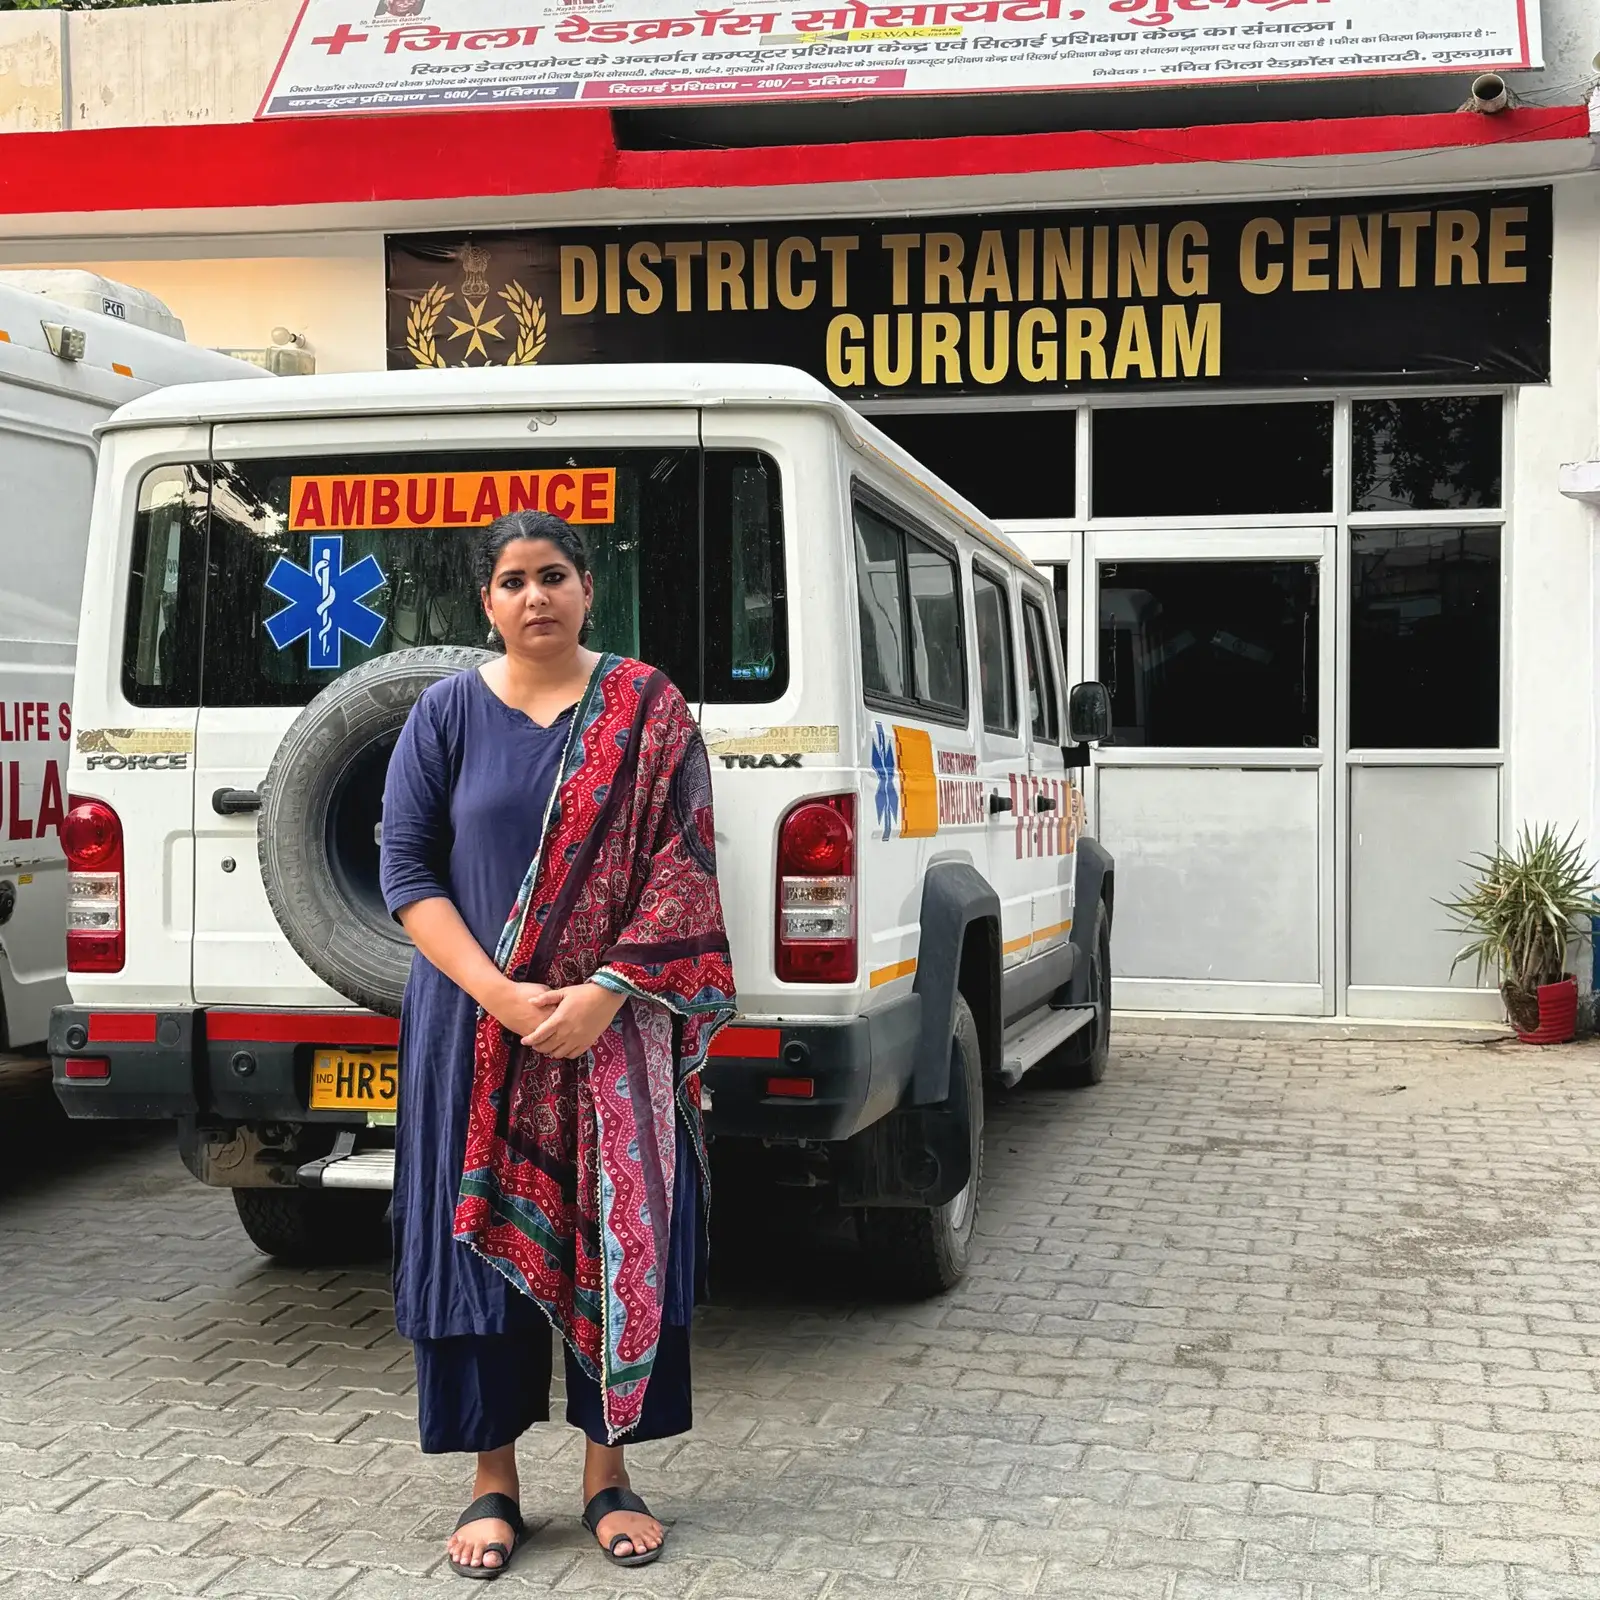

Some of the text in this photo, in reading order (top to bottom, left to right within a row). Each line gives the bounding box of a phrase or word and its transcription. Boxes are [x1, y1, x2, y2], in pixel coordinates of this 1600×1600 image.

[384, 25, 546, 54] जिला
[860, 30, 925, 39] SEWAK
[411, 62, 473, 75] स्किल
[585, 53, 609, 66] के
[612, 49, 699, 65] अन्तर्गत
[702, 48, 790, 63] कम्प्यूटर
[792, 43, 873, 59] प्रशिक्षण
[878, 40, 931, 54] केन्द्र
[935, 37, 968, 51] एवं
[973, 33, 1048, 49] सिलाई
[1051, 31, 1138, 47] प्रशिक्षण
[1143, 27, 1199, 40] केन्द्र
[1202, 25, 1237, 37] का
[1241, 21, 1336, 35] संचालन
[1026, 51, 1058, 60] सिलाई
[1124, 48, 1138, 56] का
[1253, 40, 1279, 49] किया
[1297, 40, 1316, 48] रहा
[1215, 59, 1264, 70] जिला
[608, 82, 670, 94] सिलाई
[670, 81, 738, 92] प्रशिक्षण
[808, 75, 879, 87] प्रतिमाह
[360, 93, 426, 105] प्रशिक्षण
[492, 86, 560, 98] प्रतिमाह
[559, 206, 1529, 316] DISTRICT TRAINING CENTRE
[825, 303, 1221, 388] GURUGRAM
[294, 473, 609, 527] AMBULANCE
[0, 702, 50, 741] LIFE
[794, 727, 838, 737] FORCE
[86, 754, 187, 770] FORCE
[719, 753, 803, 769] TRAX
[938, 779, 984, 825] AMBULANCE
[316, 1073, 333, 1084] IND
[336, 1062, 398, 1100] HR5
